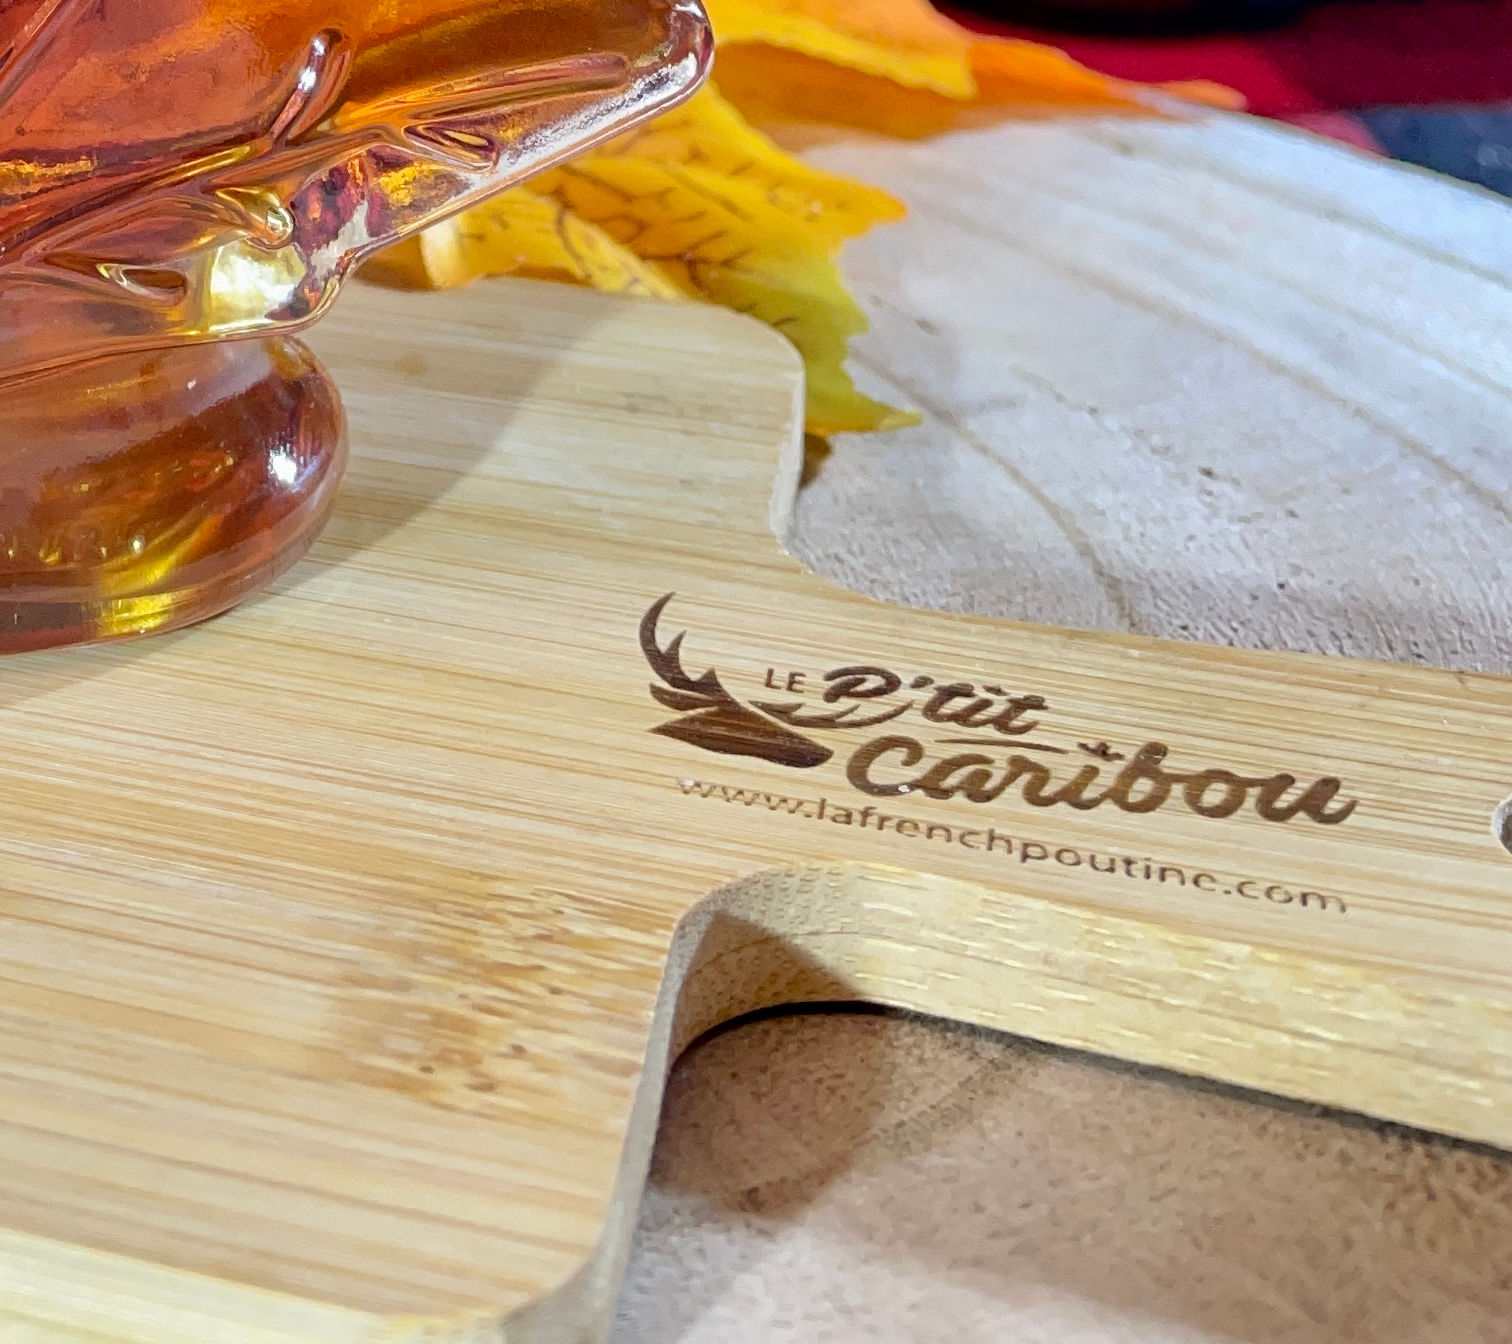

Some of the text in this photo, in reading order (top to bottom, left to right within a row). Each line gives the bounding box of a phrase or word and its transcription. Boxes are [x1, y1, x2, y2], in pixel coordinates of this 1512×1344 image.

[763, 664, 1049, 736] LE P'tit
[845, 734, 1359, 826] Caribou
[676, 776, 1347, 914] www.lafrenchpoutine.com
